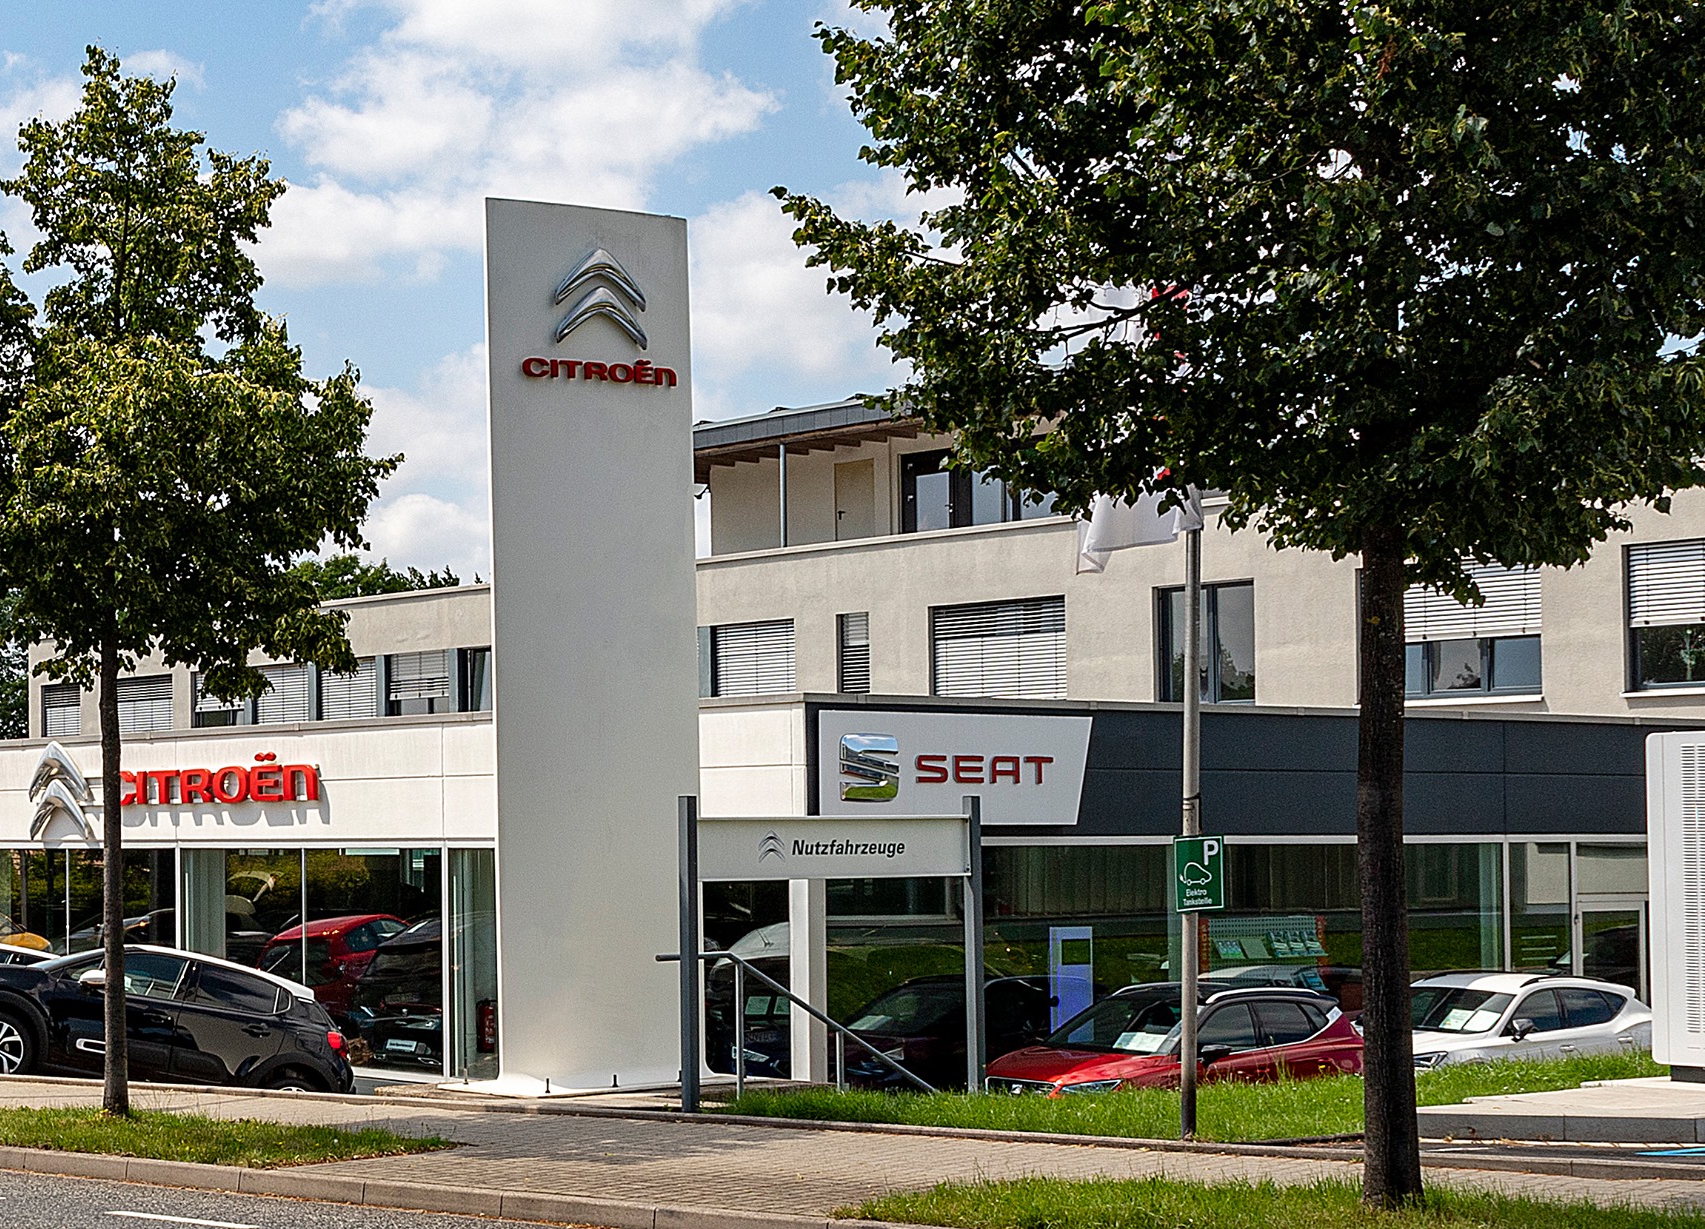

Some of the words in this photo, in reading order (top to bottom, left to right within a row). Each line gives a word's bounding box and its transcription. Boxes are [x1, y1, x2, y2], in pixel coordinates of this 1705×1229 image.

[521, 357, 678, 387] CITROËN
[915, 755, 1054, 785] SEAT
[791, 839, 906, 858] Nutzfahrzeuge
[1204, 840, 1219, 866] P
[1185, 888, 1208, 897] Elektro
